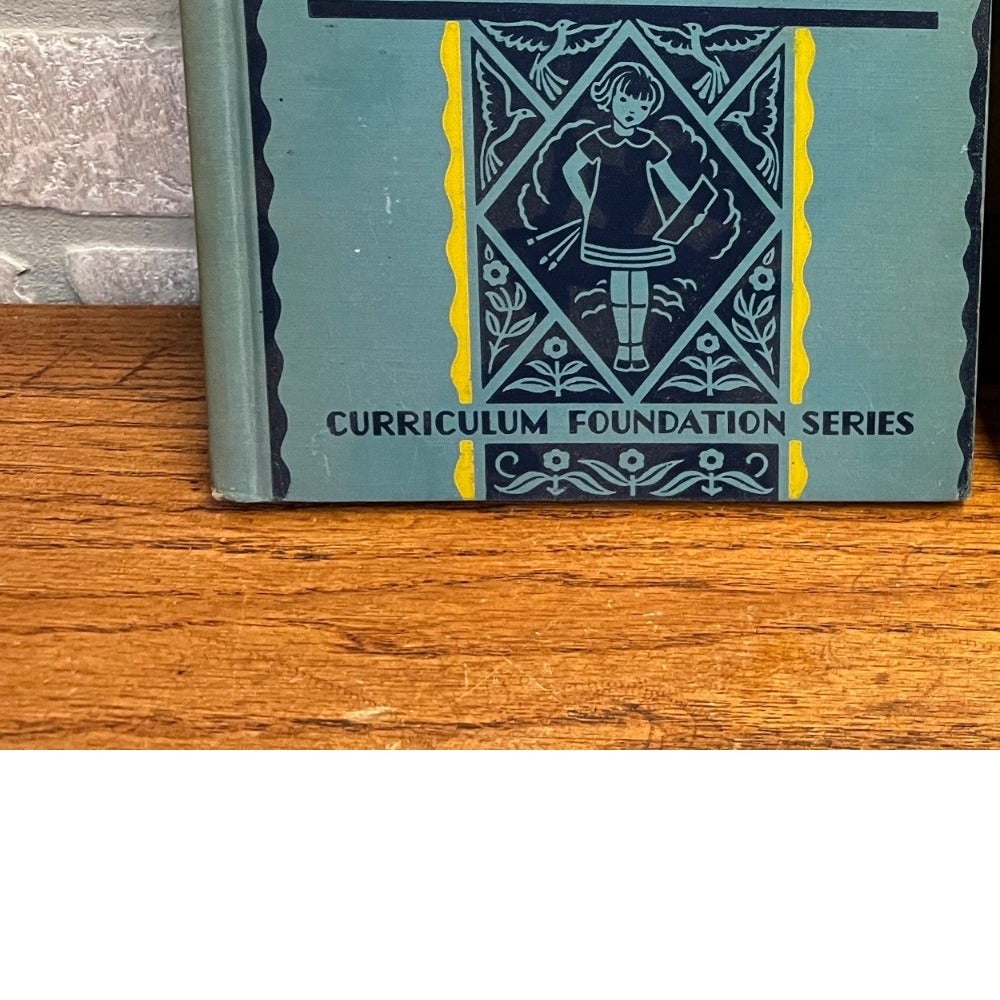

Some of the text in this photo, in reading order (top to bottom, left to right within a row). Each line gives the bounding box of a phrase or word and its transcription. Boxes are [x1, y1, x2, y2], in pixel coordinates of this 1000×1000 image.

[327, 409, 915, 436] CURRICULUM FOUNDATION SERIES
